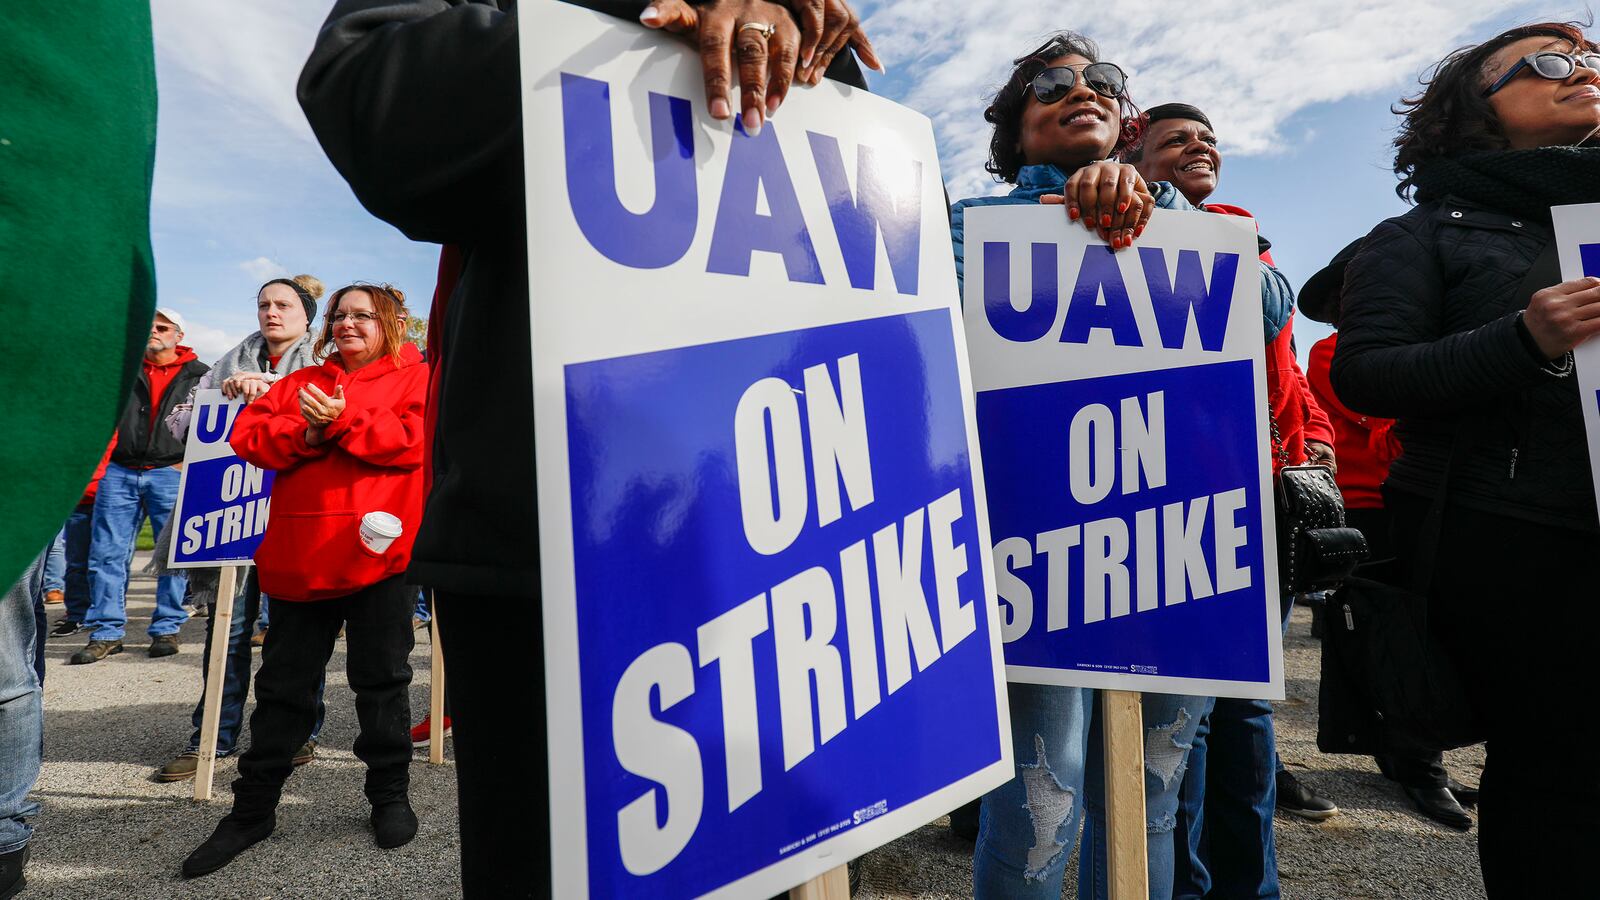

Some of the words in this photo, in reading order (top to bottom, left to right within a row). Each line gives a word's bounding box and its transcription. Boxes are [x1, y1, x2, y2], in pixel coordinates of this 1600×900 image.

[560, 72, 922, 296] UAW
[983, 241, 1240, 352] UAW
[220, 461, 264, 503] ON
[734, 352, 875, 556] ON
[1069, 390, 1167, 505] ON
[991, 487, 1252, 644] STRIKE
[612, 487, 977, 877] STRIKE
